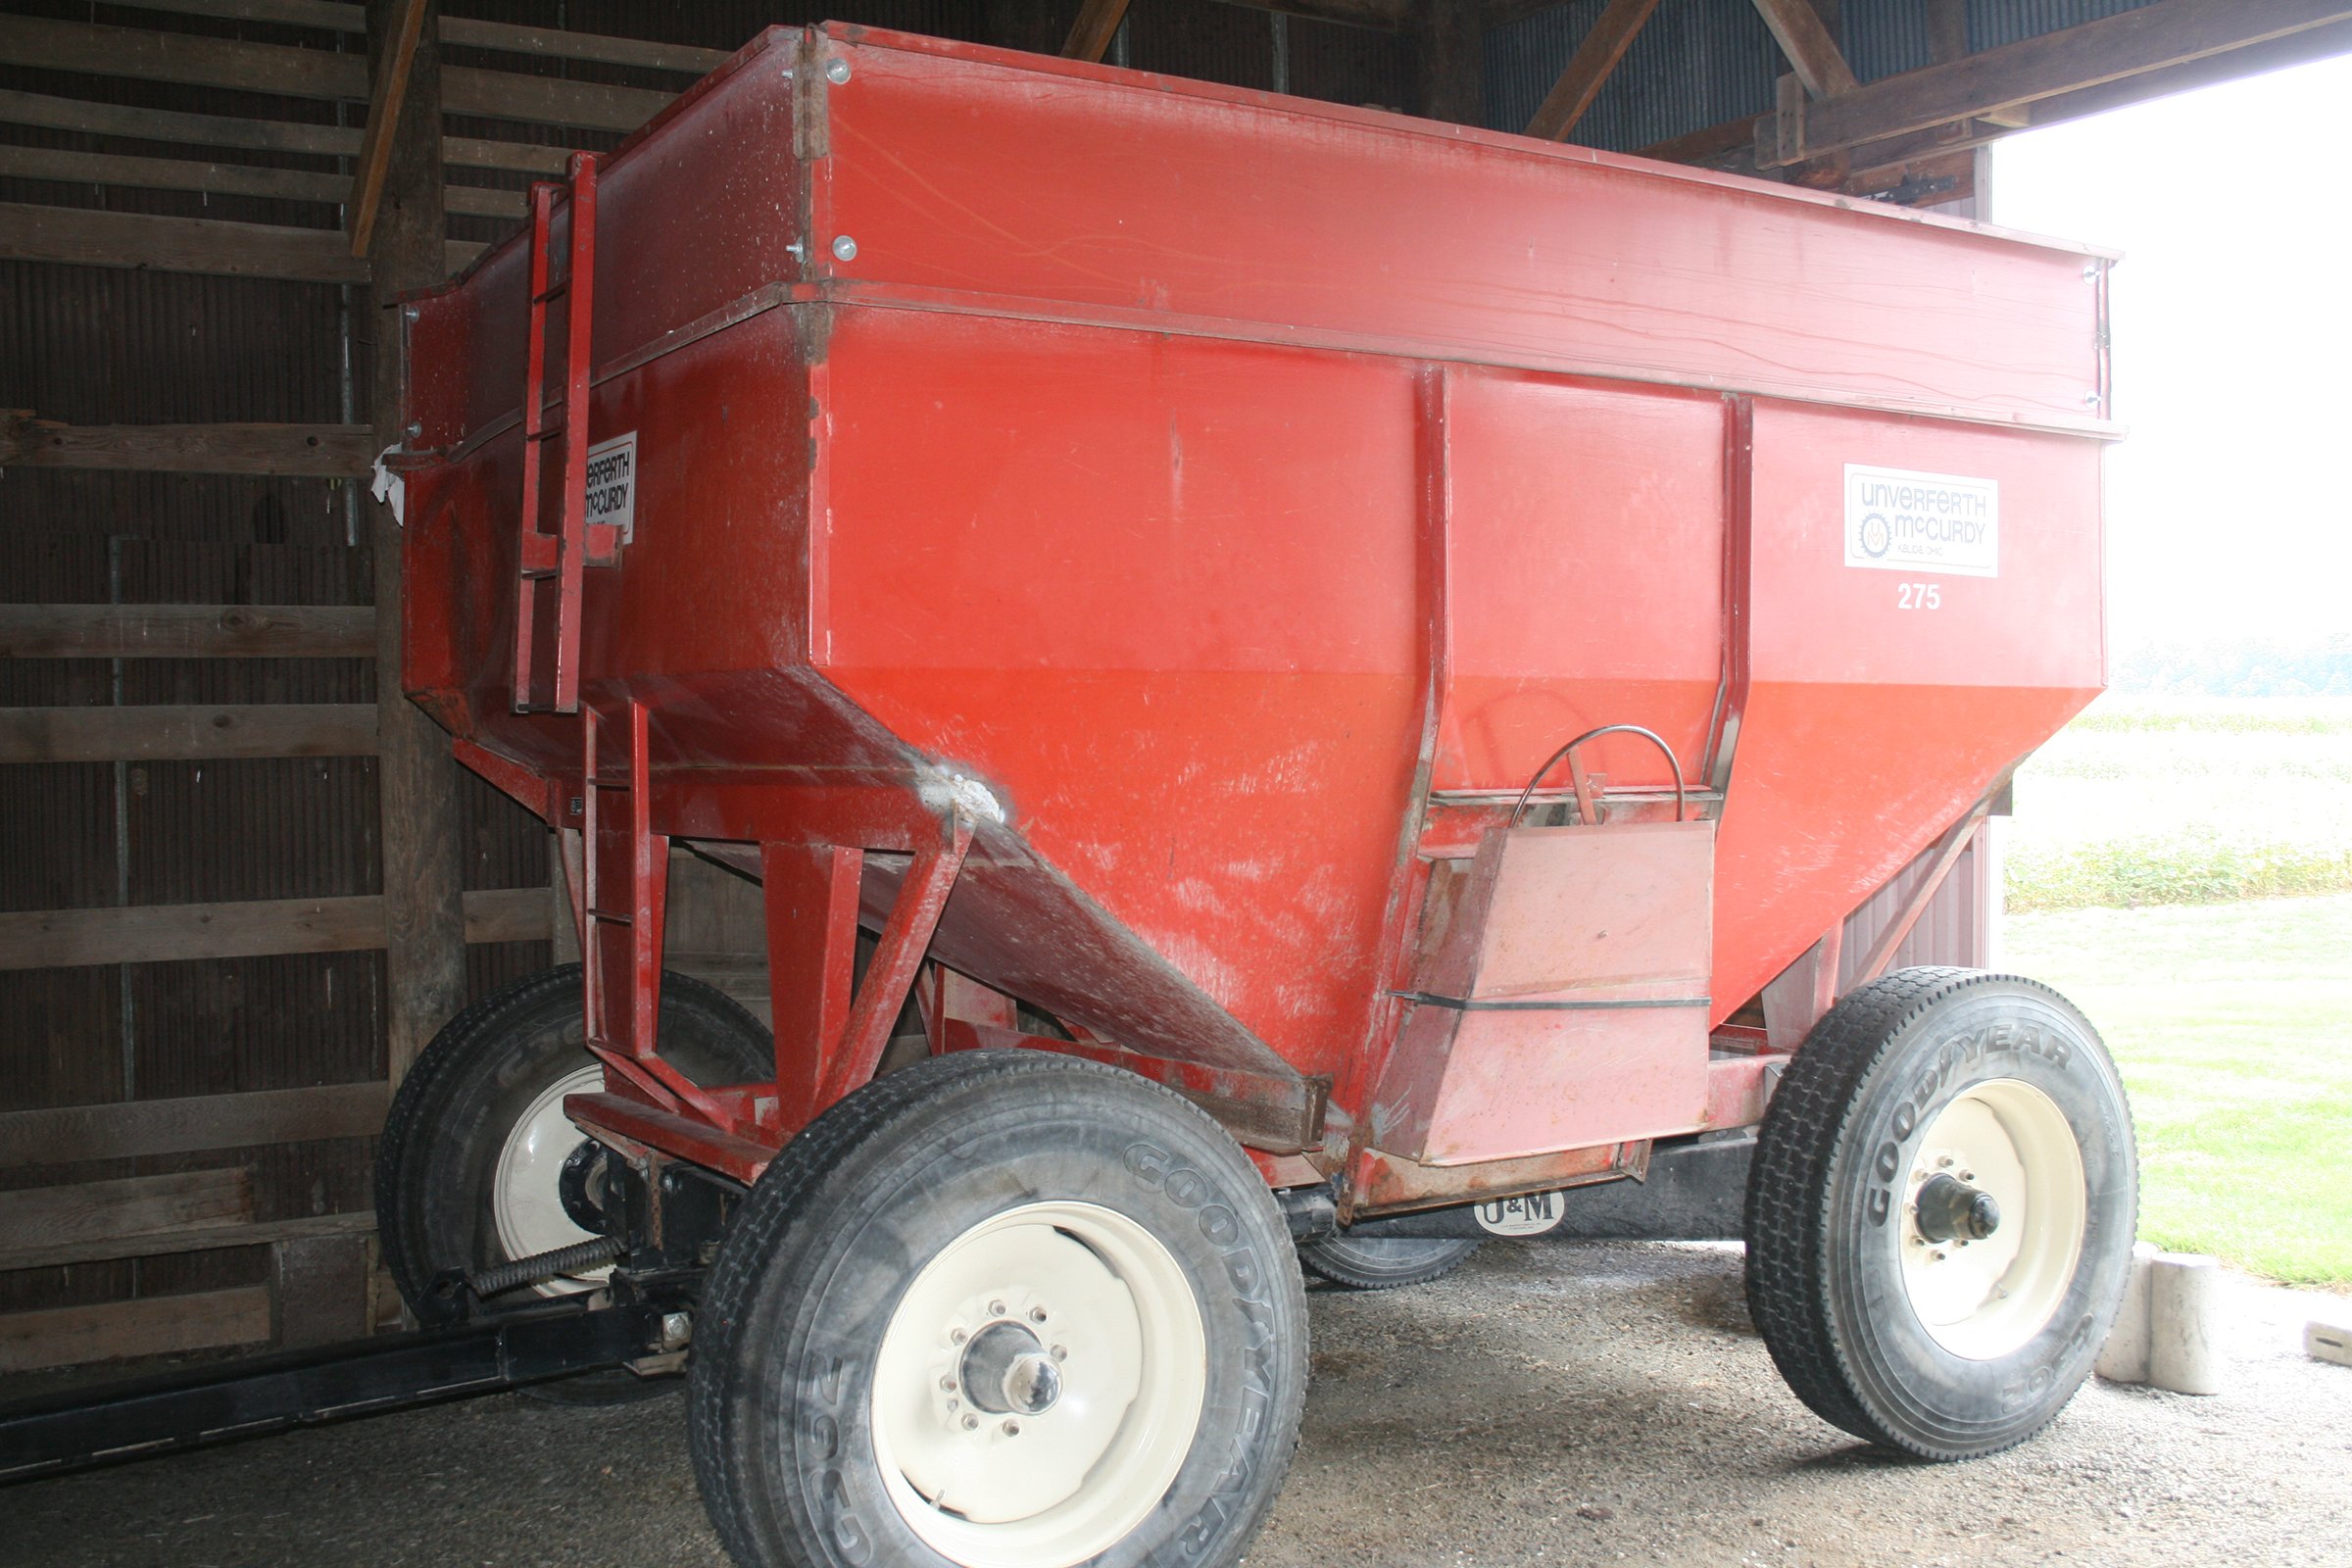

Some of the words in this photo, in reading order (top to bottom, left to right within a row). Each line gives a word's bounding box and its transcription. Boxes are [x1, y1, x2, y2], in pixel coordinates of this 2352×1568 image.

[1897, 582, 1941, 611] 275
[1868, 1023, 2074, 1228] GOODYEAR
[1483, 1189, 1555, 1225] J&M
[1123, 1143, 1276, 1556] GOODYEAR
